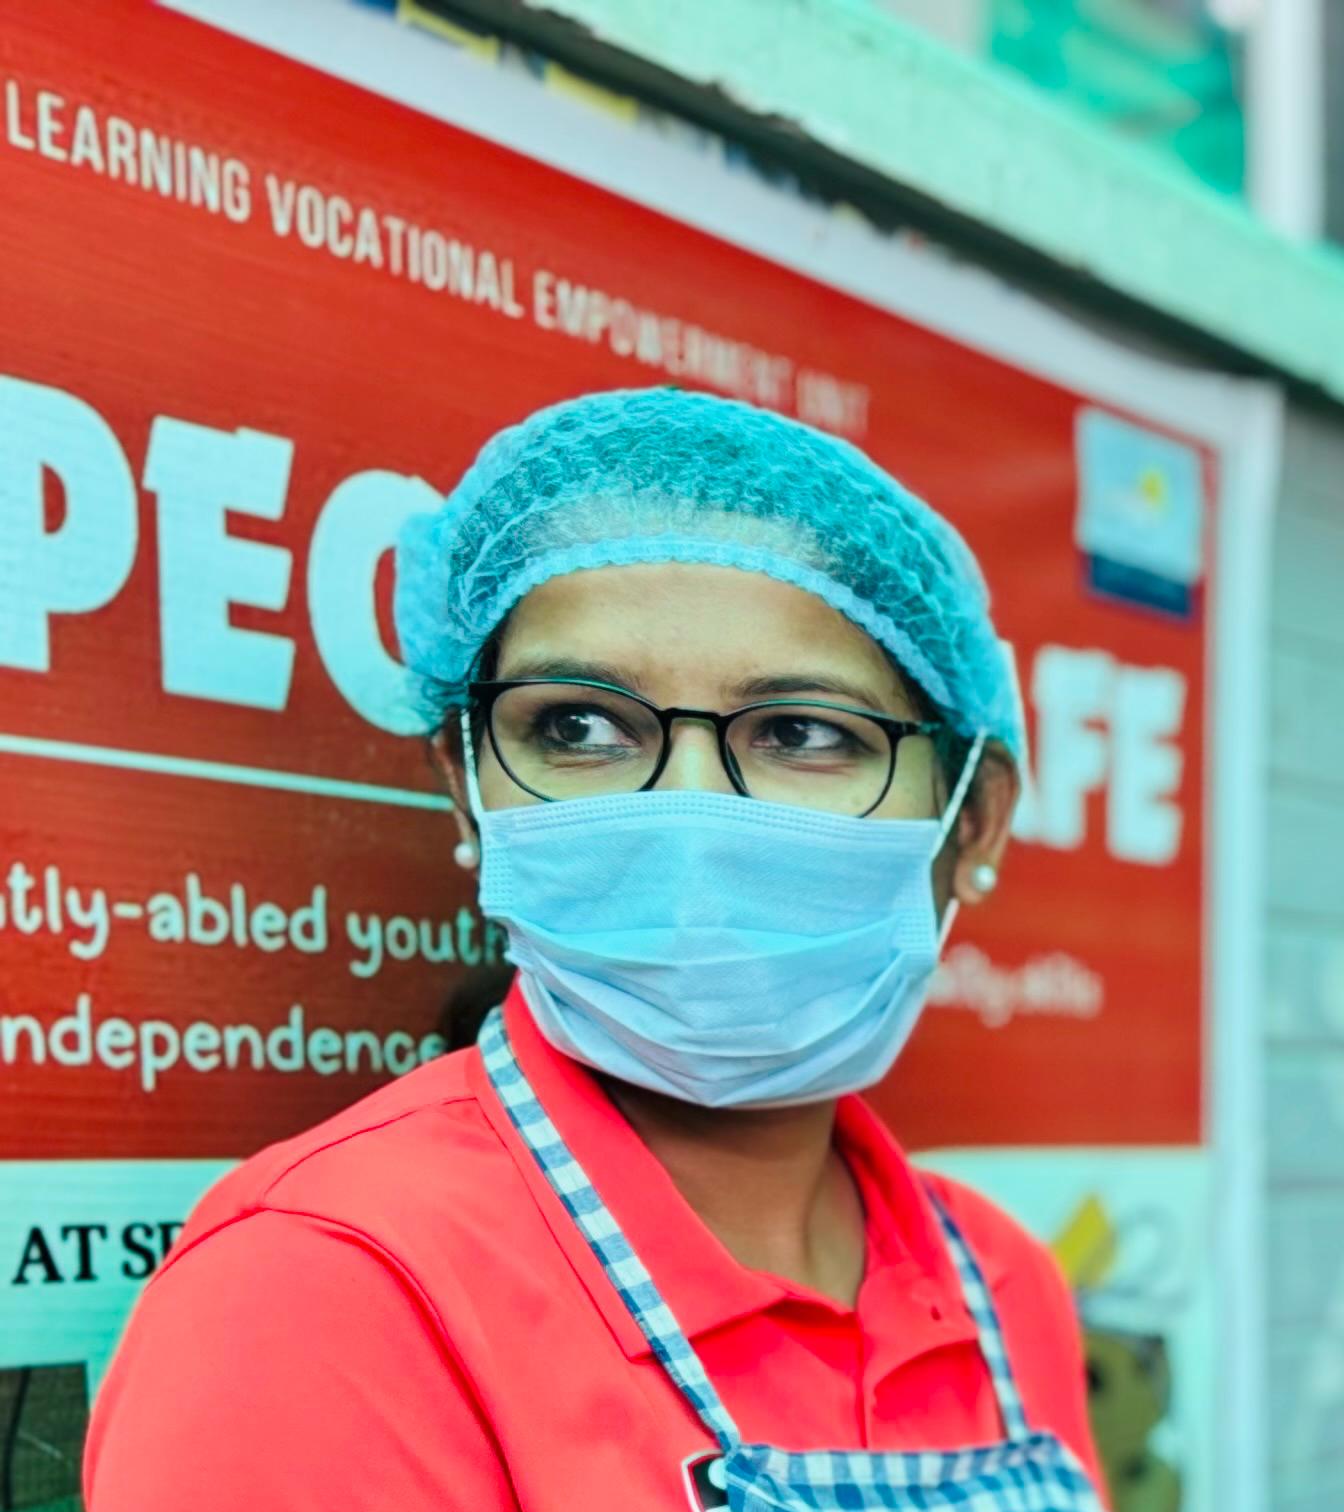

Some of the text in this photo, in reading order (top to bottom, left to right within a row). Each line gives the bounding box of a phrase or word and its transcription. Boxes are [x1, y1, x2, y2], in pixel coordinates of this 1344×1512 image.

[6, 80, 252, 224] LEARNING
[265, 173, 525, 319] VOCATIONAL
[0, 862, 328, 959] tly-abled
[12, 1224, 107, 1285] AT
